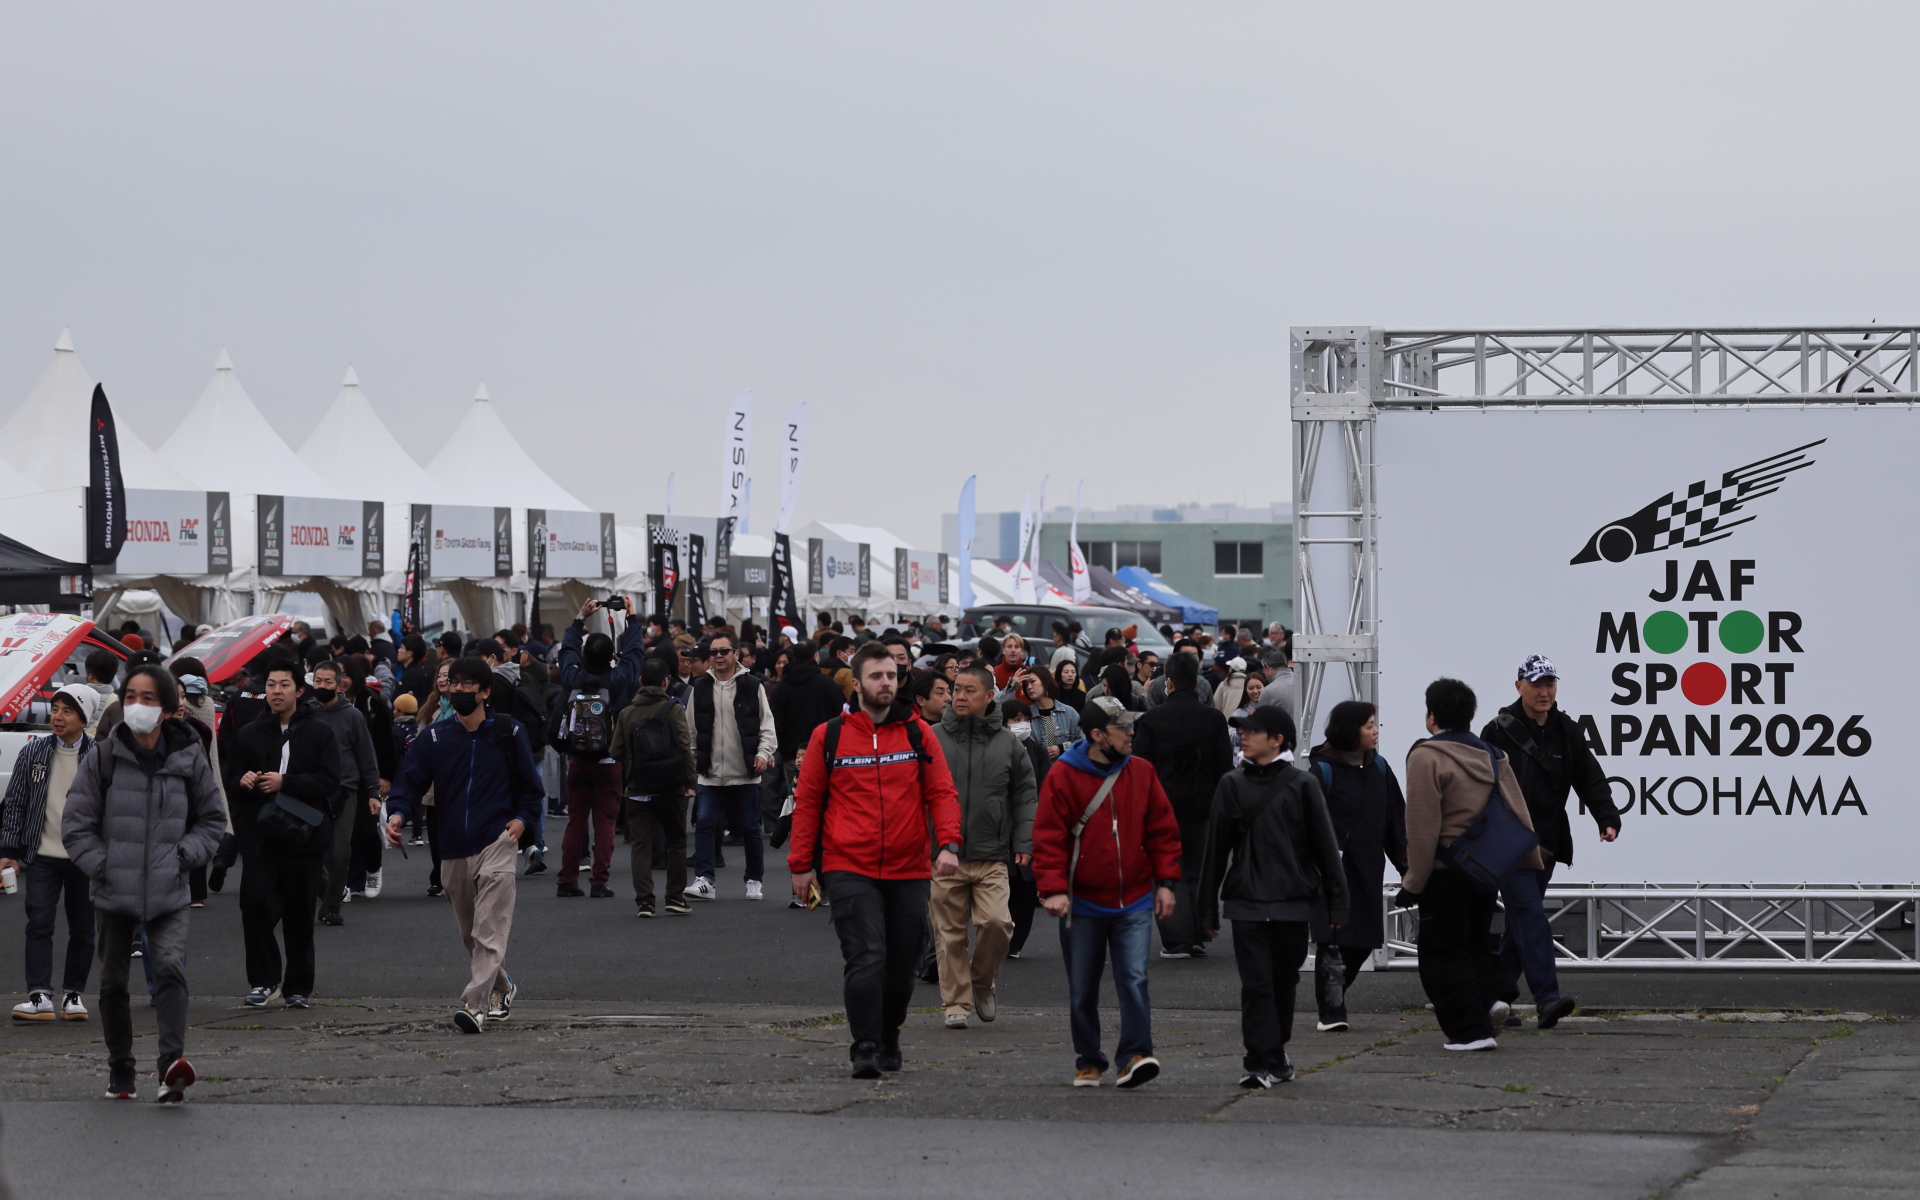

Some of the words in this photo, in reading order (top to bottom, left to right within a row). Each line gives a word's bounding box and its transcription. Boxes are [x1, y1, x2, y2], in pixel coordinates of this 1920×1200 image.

[98, 434, 112, 499] MITSUBISHI
[105, 501, 113, 549] MOTORS
[126, 520, 171, 542] HONDA
[290, 525, 330, 546] HONDA
[744, 568, 766, 583] NISSAN
[1648, 560, 1756, 602] JAF
[1595, 610, 1805, 654] MOTOR
[1610, 661, 1795, 706] SPORT
[1577, 714, 1721, 756] APAN
[1729, 713, 1872, 757] 2026
[1579, 775, 1868, 817] OKOHAMA
